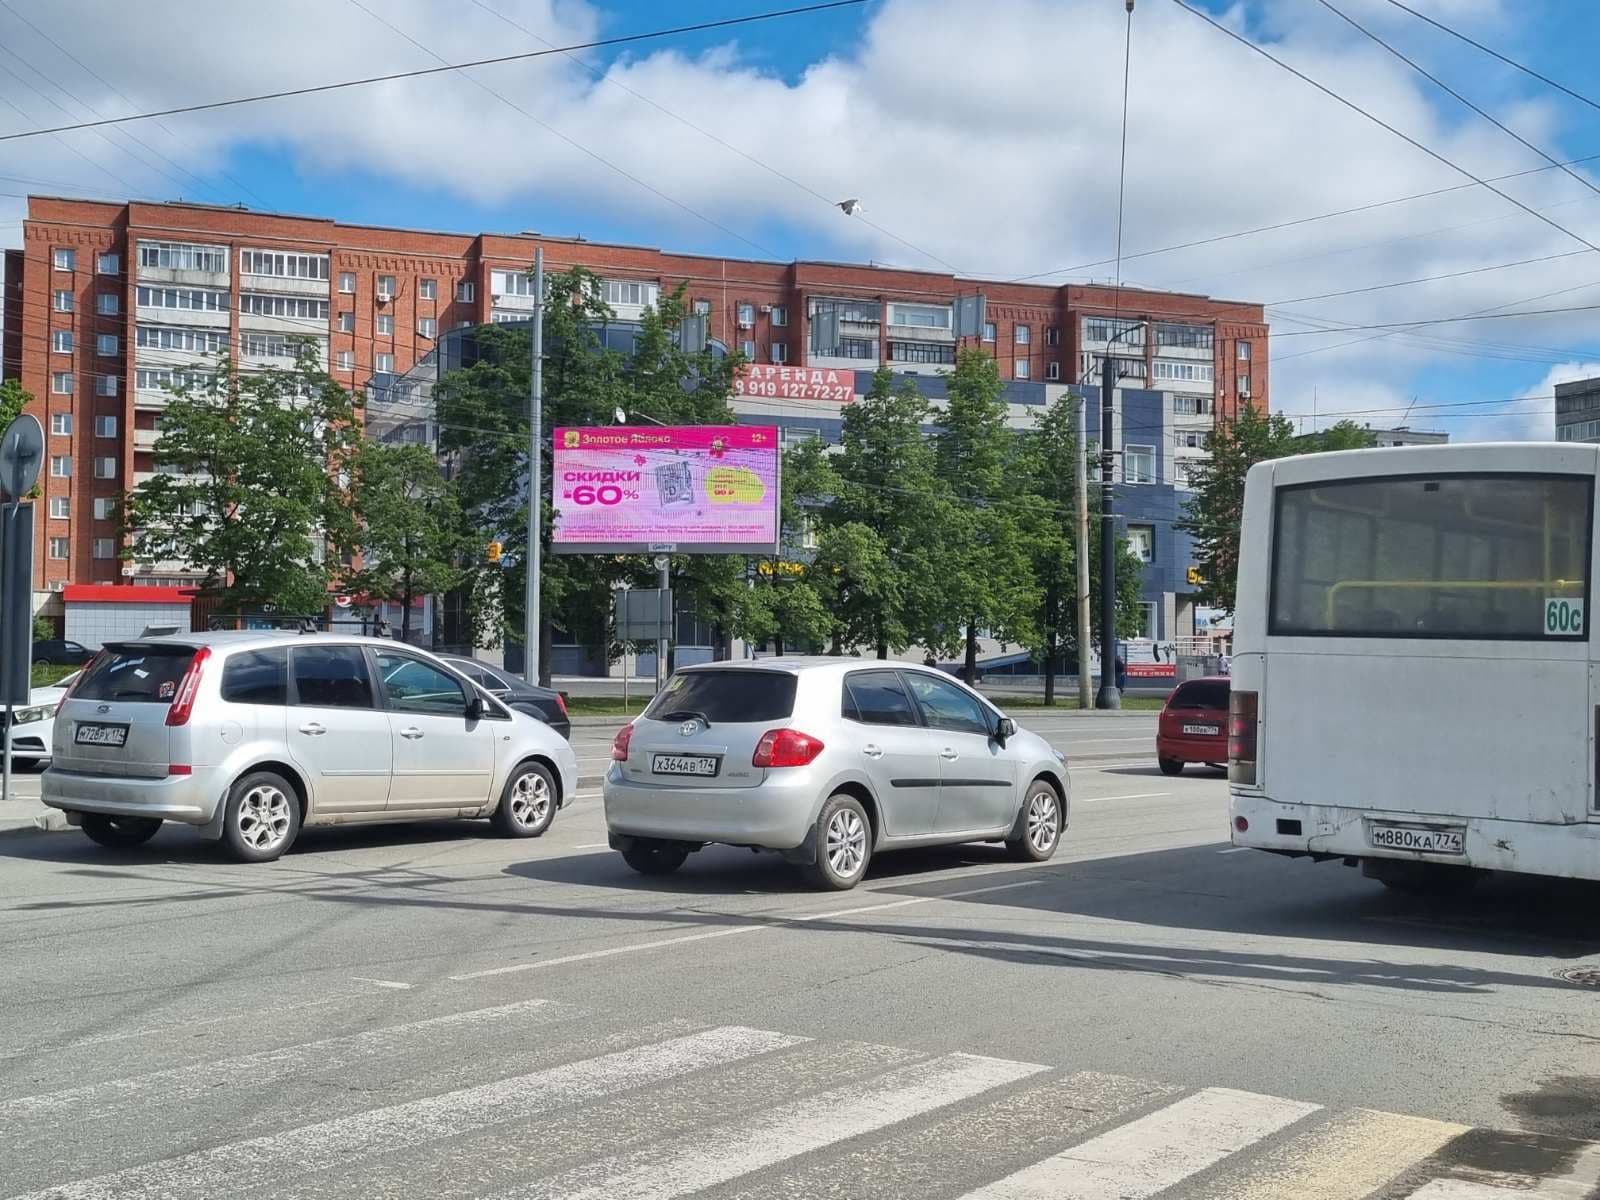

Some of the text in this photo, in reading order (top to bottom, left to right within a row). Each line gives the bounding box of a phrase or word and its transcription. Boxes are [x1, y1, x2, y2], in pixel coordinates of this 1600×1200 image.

[750, 366, 838, 384] АРЕНДА
[749, 381, 776, 396] 919
[781, 383, 852, 400] 127-72-27
